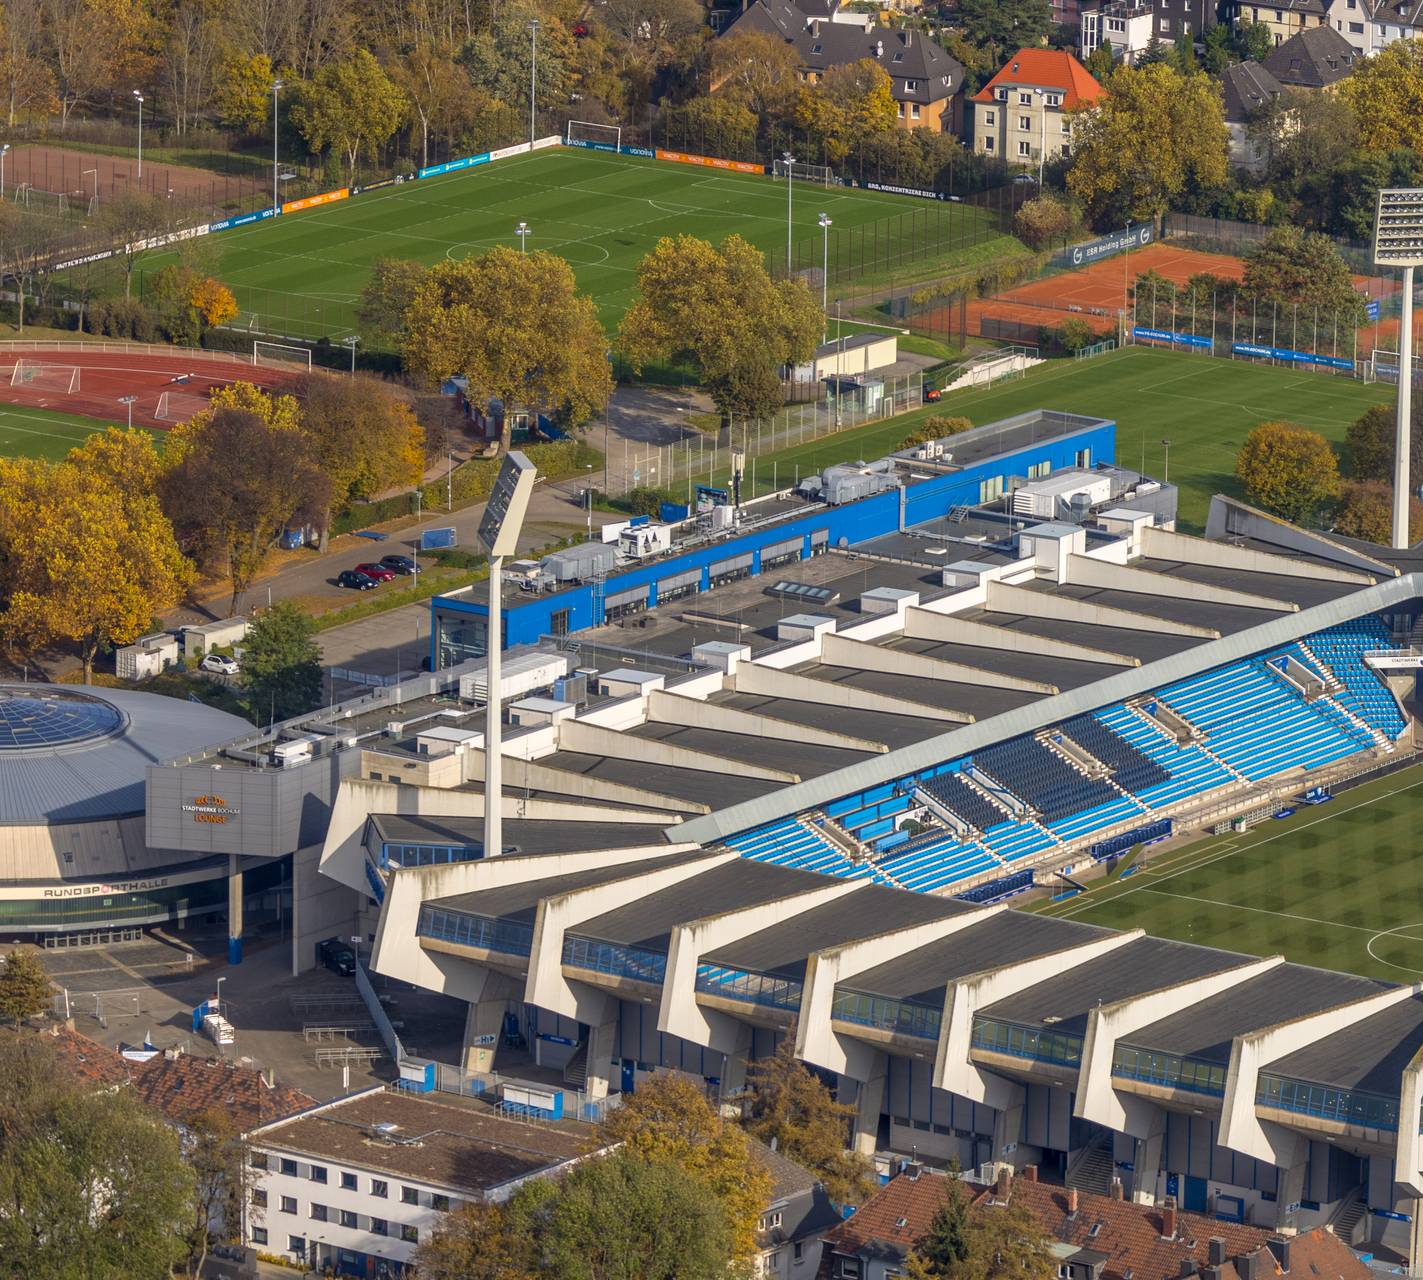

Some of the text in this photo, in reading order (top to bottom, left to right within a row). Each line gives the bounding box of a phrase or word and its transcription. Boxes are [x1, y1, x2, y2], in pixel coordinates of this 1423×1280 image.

[1099, 240, 1119, 254] Holding
[182, 804, 217, 814] STADTWERKE
[44, 878, 169, 897] RUNDSPORTHALLE
